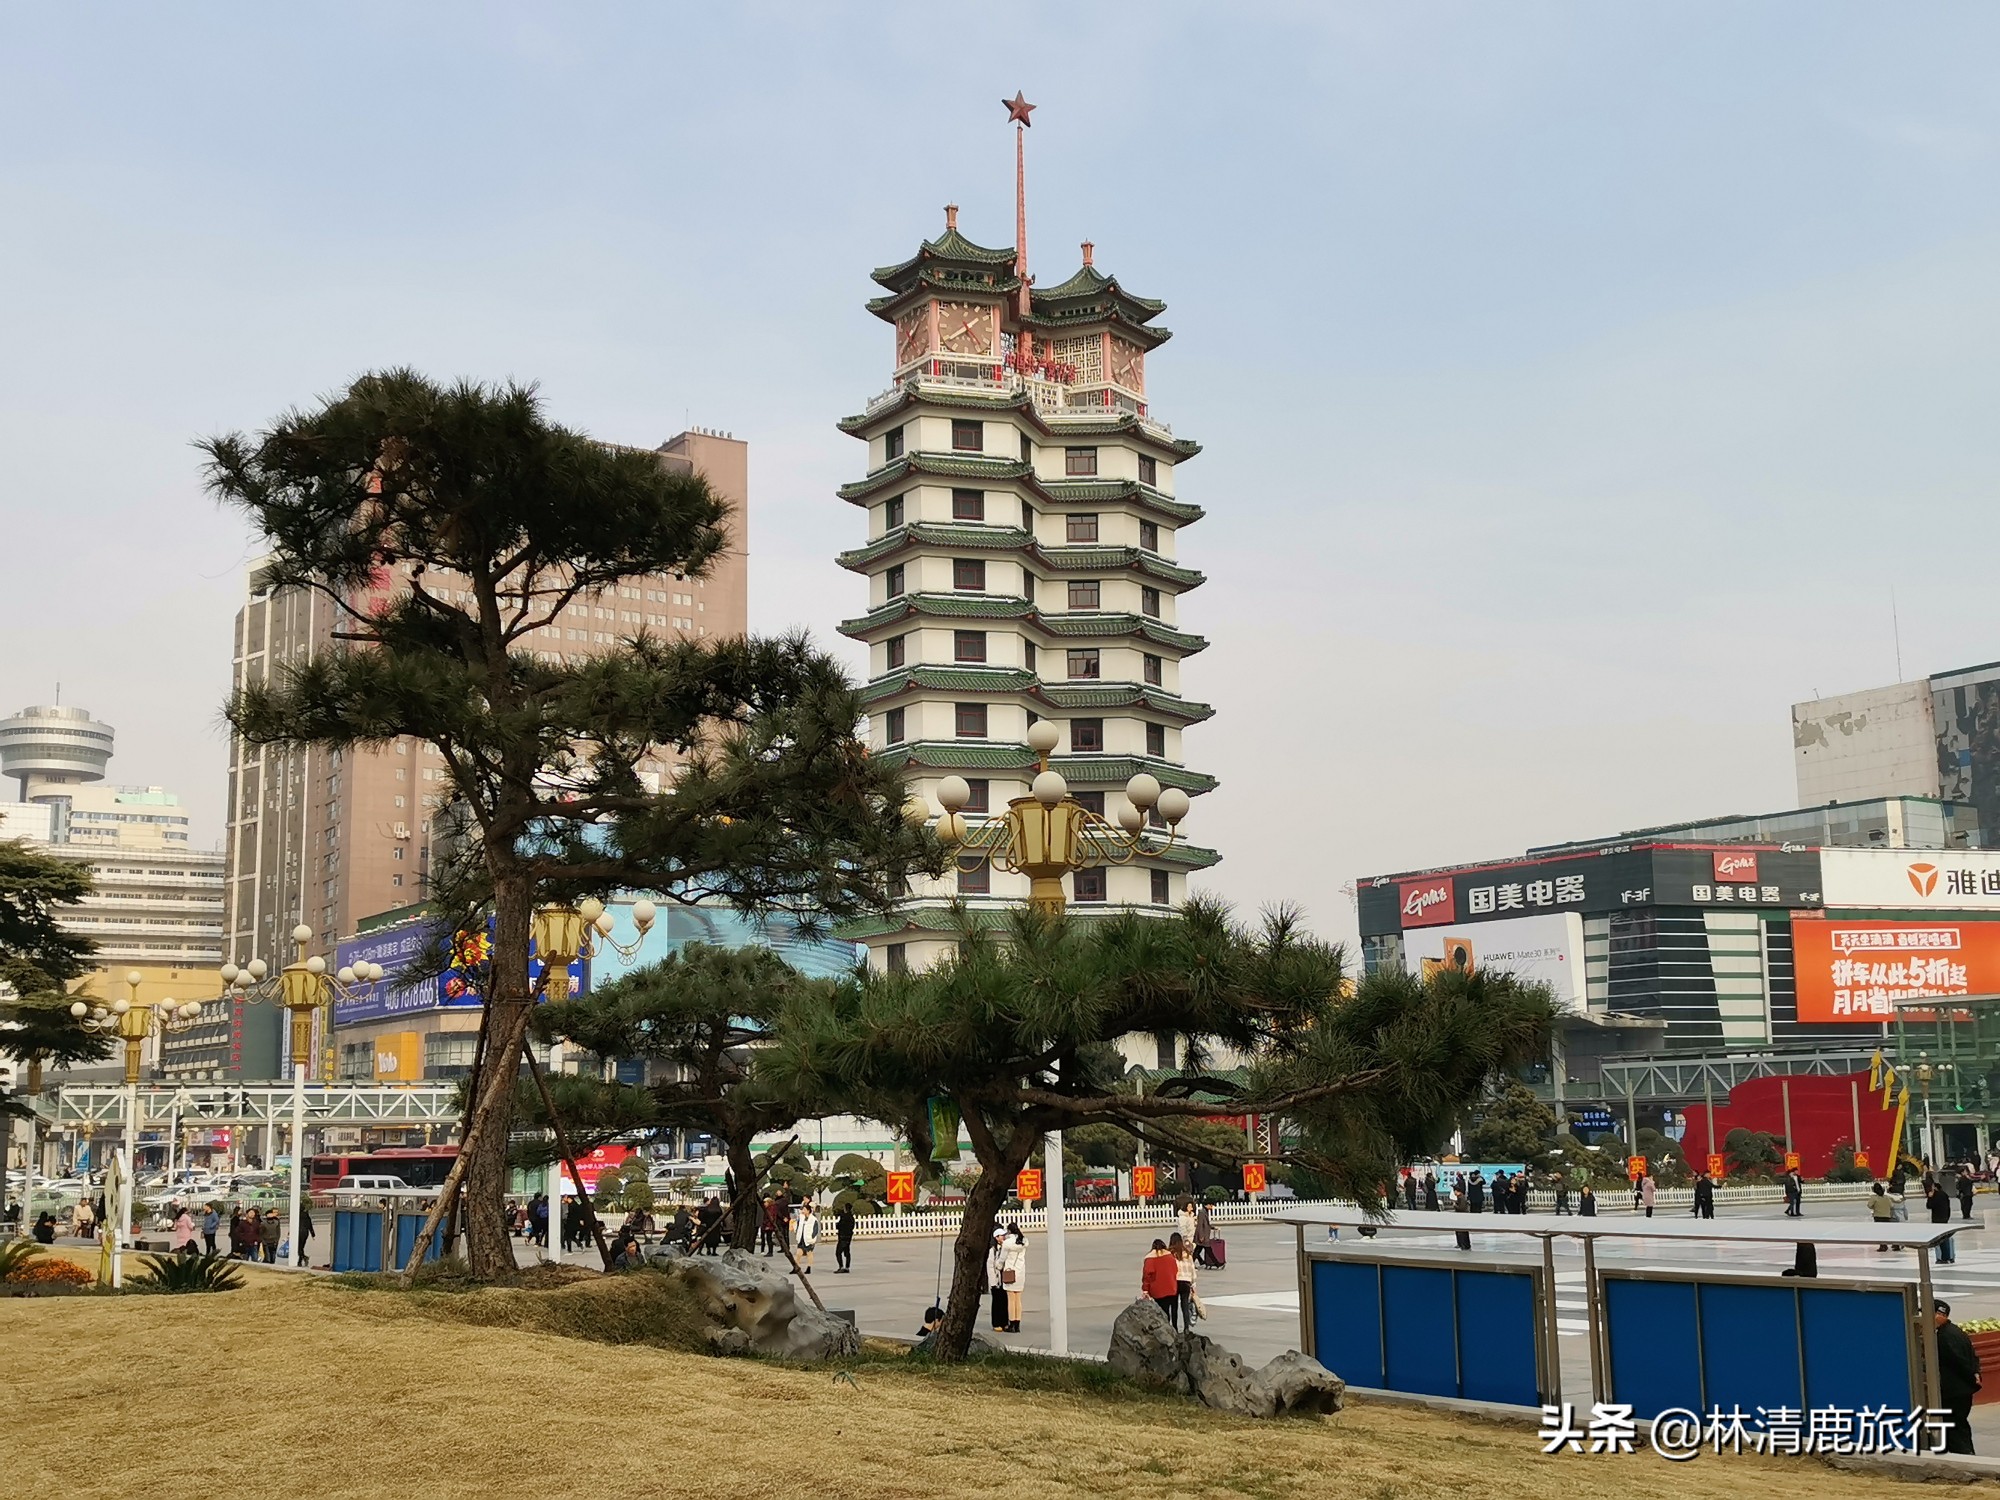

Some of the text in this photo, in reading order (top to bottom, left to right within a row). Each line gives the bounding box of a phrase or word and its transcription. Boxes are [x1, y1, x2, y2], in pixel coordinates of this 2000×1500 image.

[1468, 874, 1586, 915] 国美电器
[1692, 884, 1780, 903] 国美电器
[1483, 951, 1515, 962] HUAWEI
[1517, 949, 1542, 959] Mate30
[1831, 956, 1968, 987] 拼车从此5折起
[1709, 1157, 1722, 1175] 记
[889, 1174, 912, 1199] 不
[1019, 1172, 1039, 1197] 忘
[1135, 1170, 1153, 1193] 初
[1246, 1167, 1263, 1189] 心
